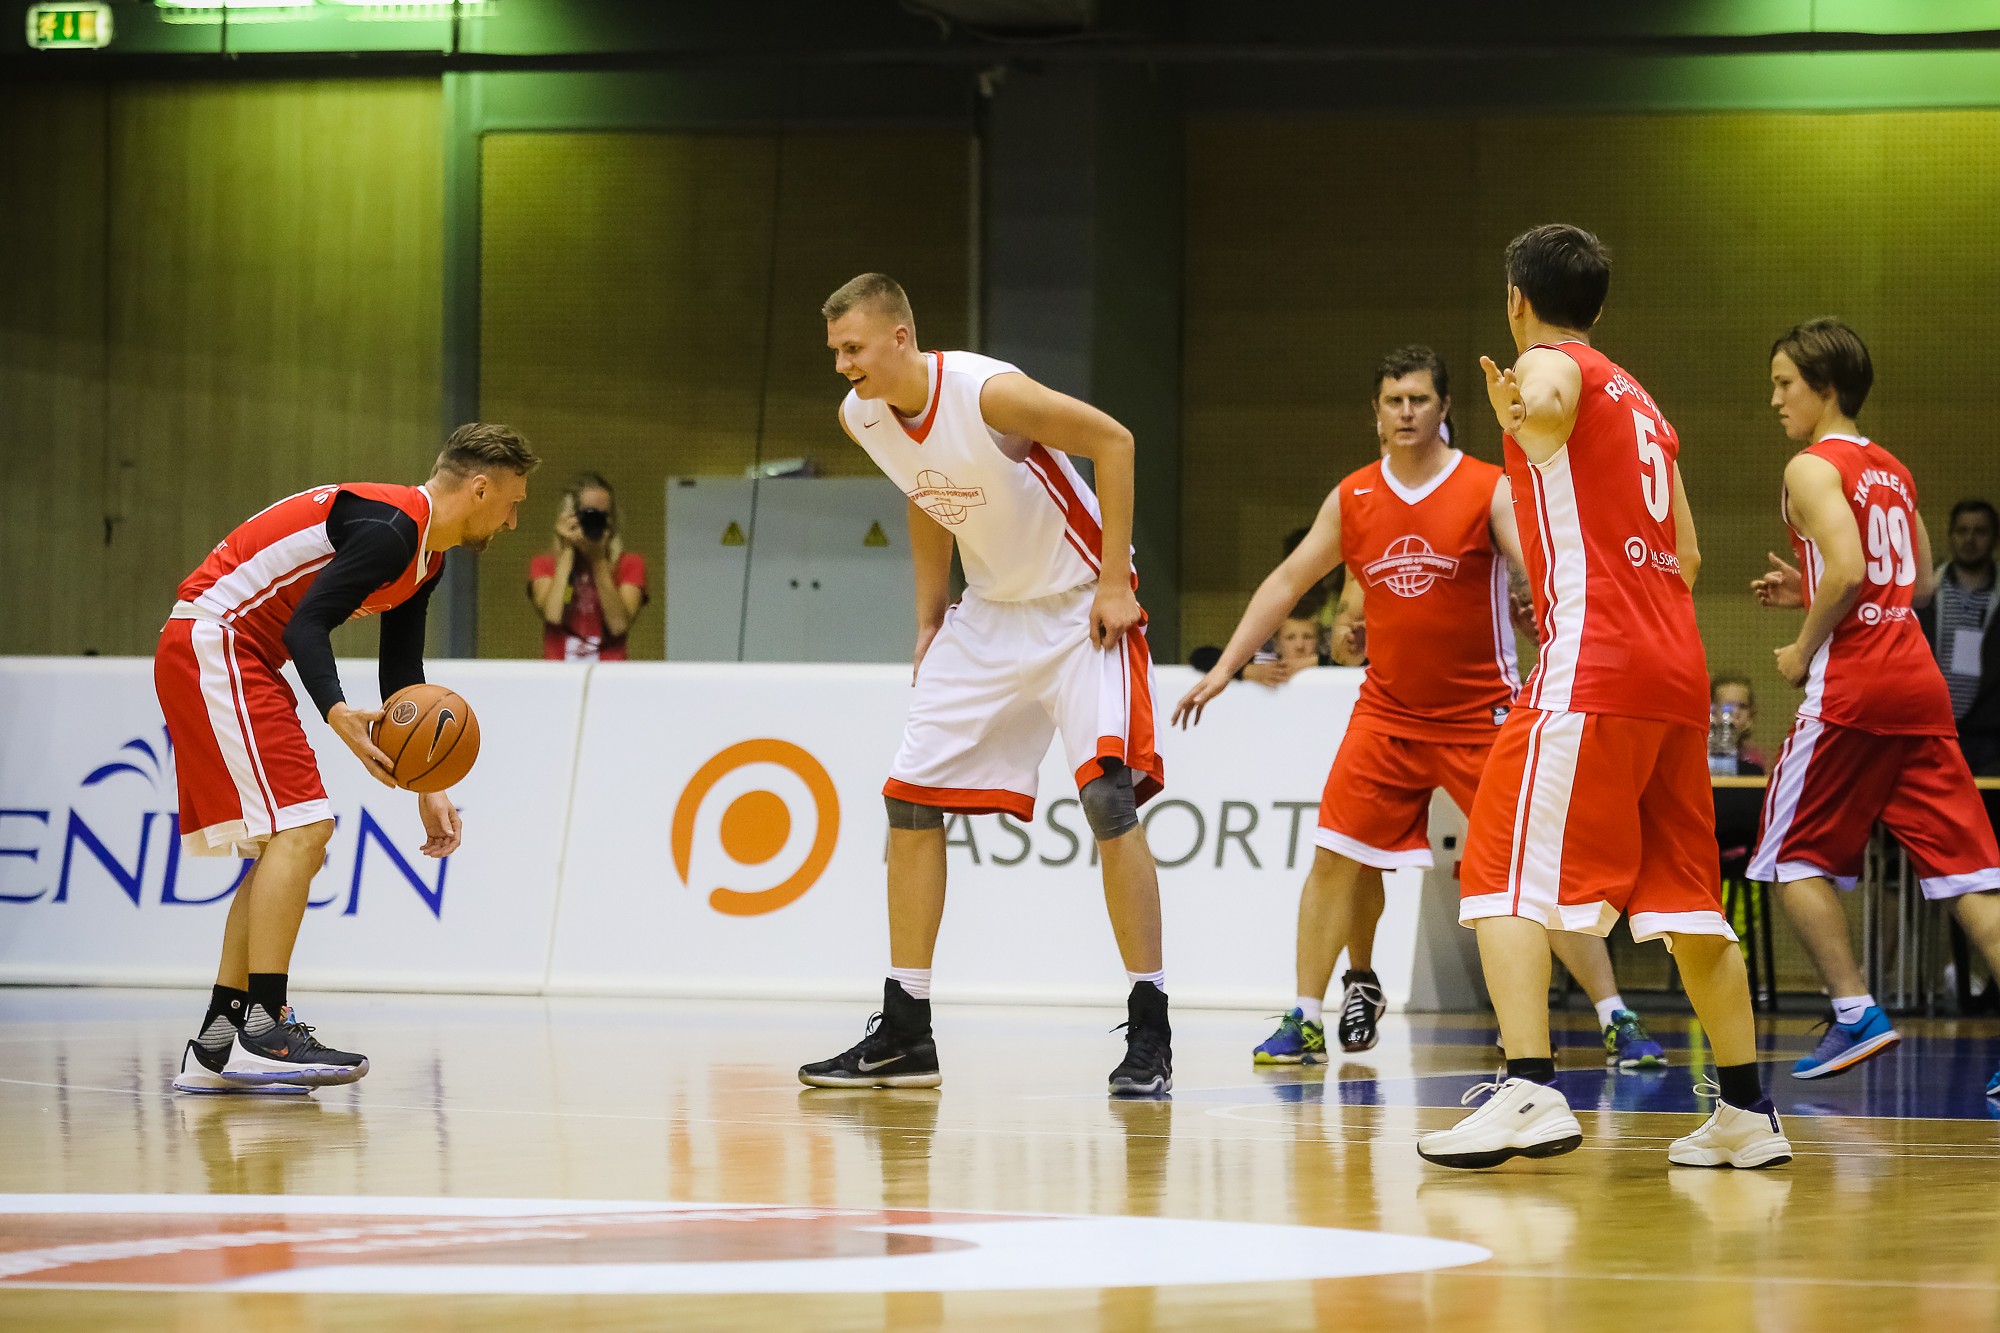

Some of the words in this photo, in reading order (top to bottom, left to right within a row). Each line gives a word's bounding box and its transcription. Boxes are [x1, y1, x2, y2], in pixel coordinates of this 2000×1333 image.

[1632, 408, 1669, 522] 5
[1867, 504, 1916, 586] 99
[0, 806, 462, 921] ENDN
[884, 797, 1323, 869] ASSORT
